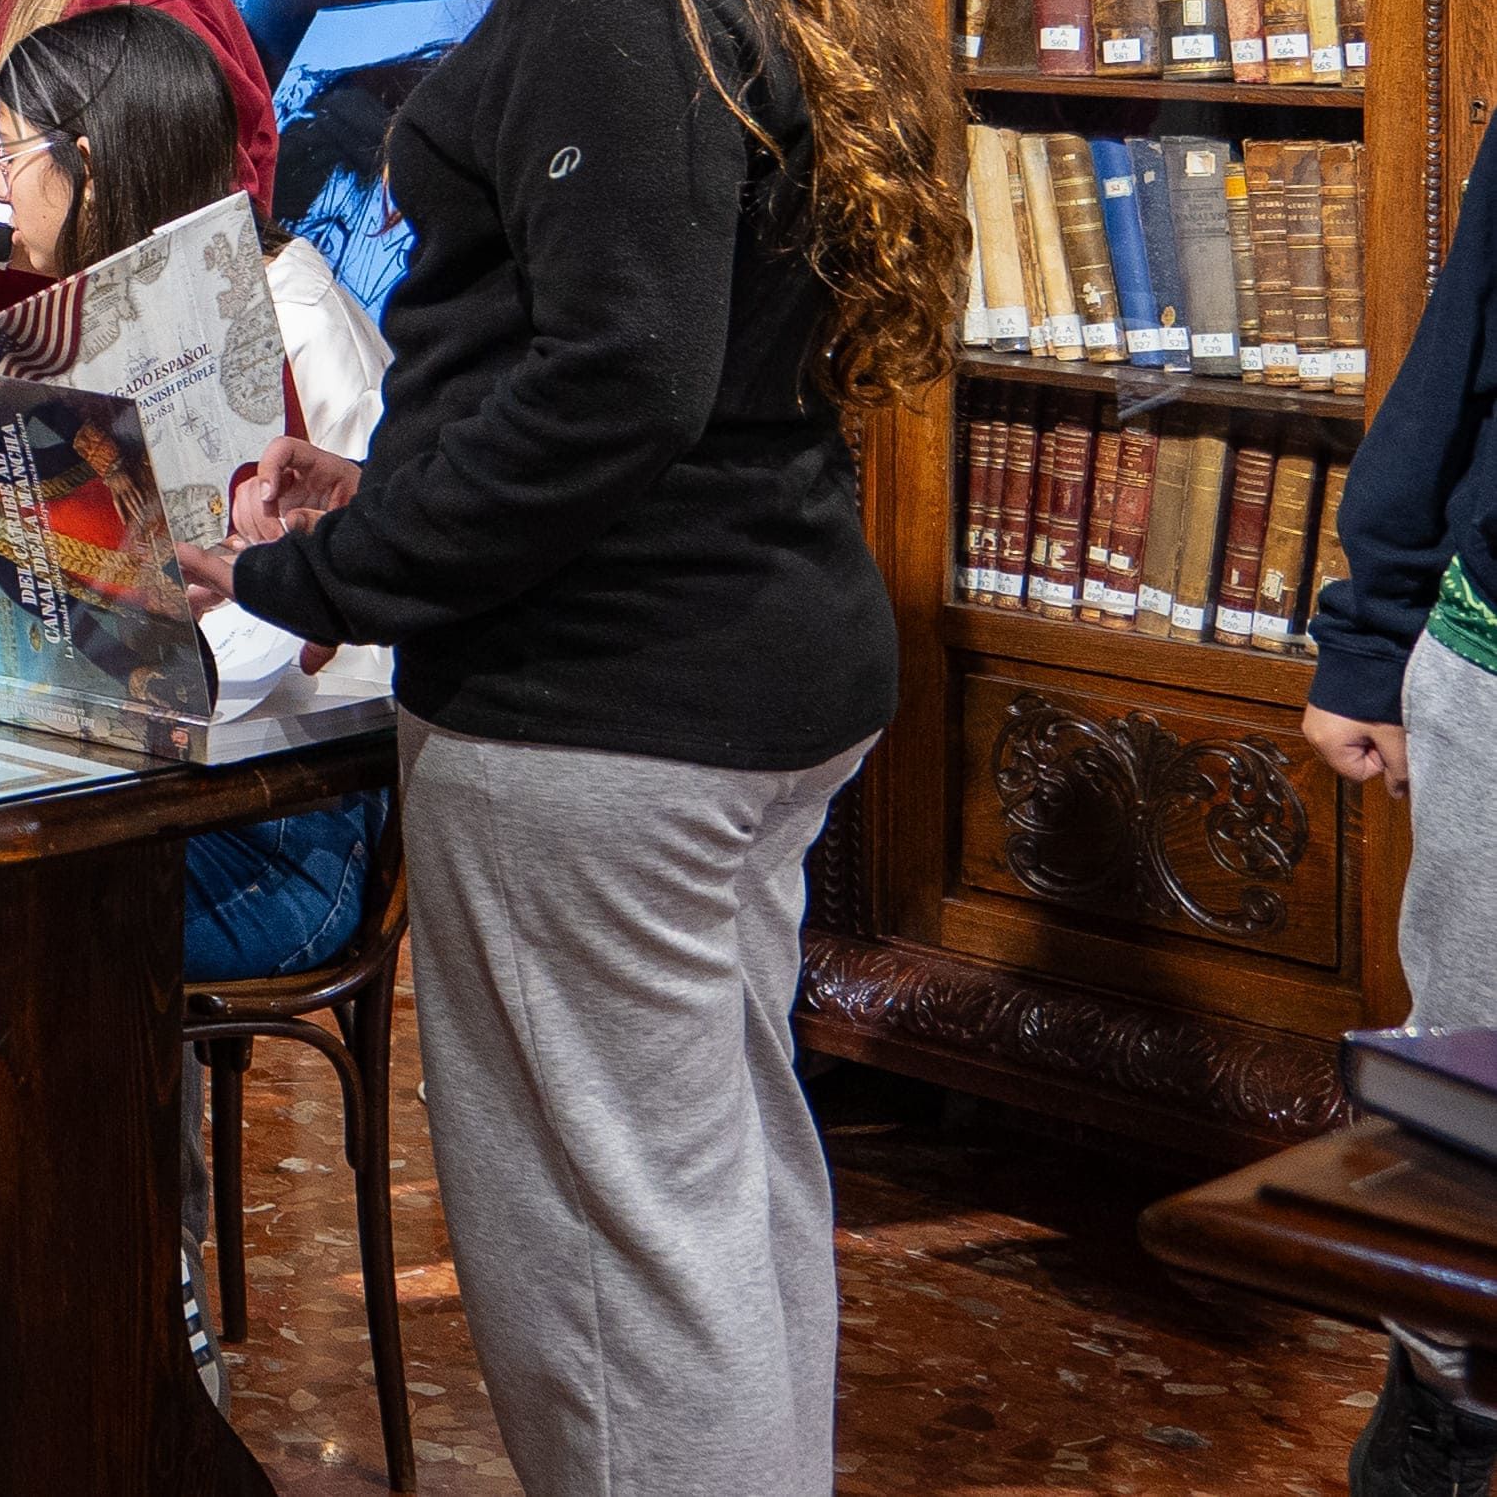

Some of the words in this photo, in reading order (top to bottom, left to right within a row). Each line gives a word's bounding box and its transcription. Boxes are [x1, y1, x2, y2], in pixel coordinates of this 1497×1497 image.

[154, 343, 212, 380] ESPAÑOL
[176, 363, 216, 392] PEOPLE
[1272, 357, 1289, 365] 531
[1336, 363, 1354, 371] 533
[0, 423, 34, 512] MANCHA
[27, 541, 49, 576] DE
[14, 562, 38, 607] DEL
[33, 578, 63, 646] CANAL
